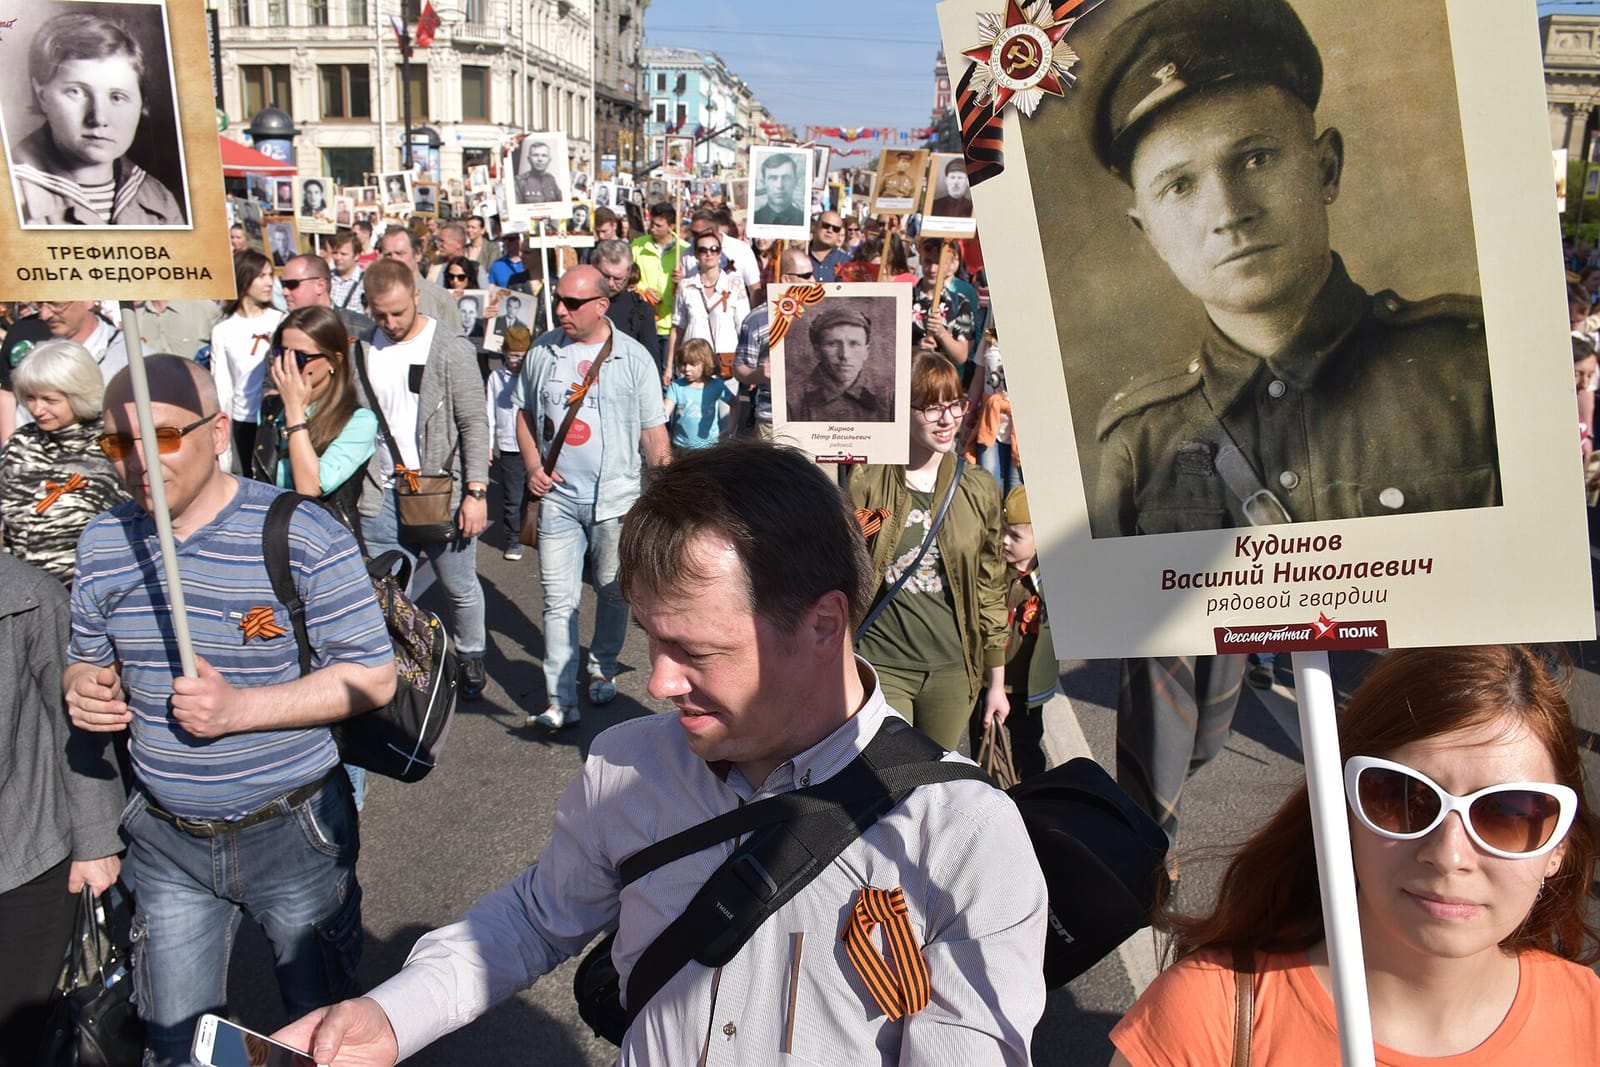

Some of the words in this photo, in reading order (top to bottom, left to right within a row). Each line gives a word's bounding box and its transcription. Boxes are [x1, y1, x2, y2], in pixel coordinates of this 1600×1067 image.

[992, 26, 1044, 87] ОТЕЧЕСТВЕННАЯ
[1034, 39, 1051, 79] ВОЙНА
[47, 246, 171, 260] ТРЕФИЛОВА
[16, 267, 83, 281] ОЛЬГА
[88, 266, 213, 283] ФЕДОРОВНА
[811, 433, 831, 441] Пётр
[832, 433, 872, 441] Васильевич
[1235, 533, 1343, 562] Кудинов
[1161, 564, 1264, 591] Василий
[1273, 557, 1434, 584] Николаевич
[1206, 590, 1292, 616] рядовой
[1299, 586, 1388, 610] гвардии
[716, 901, 735, 920] THULE
